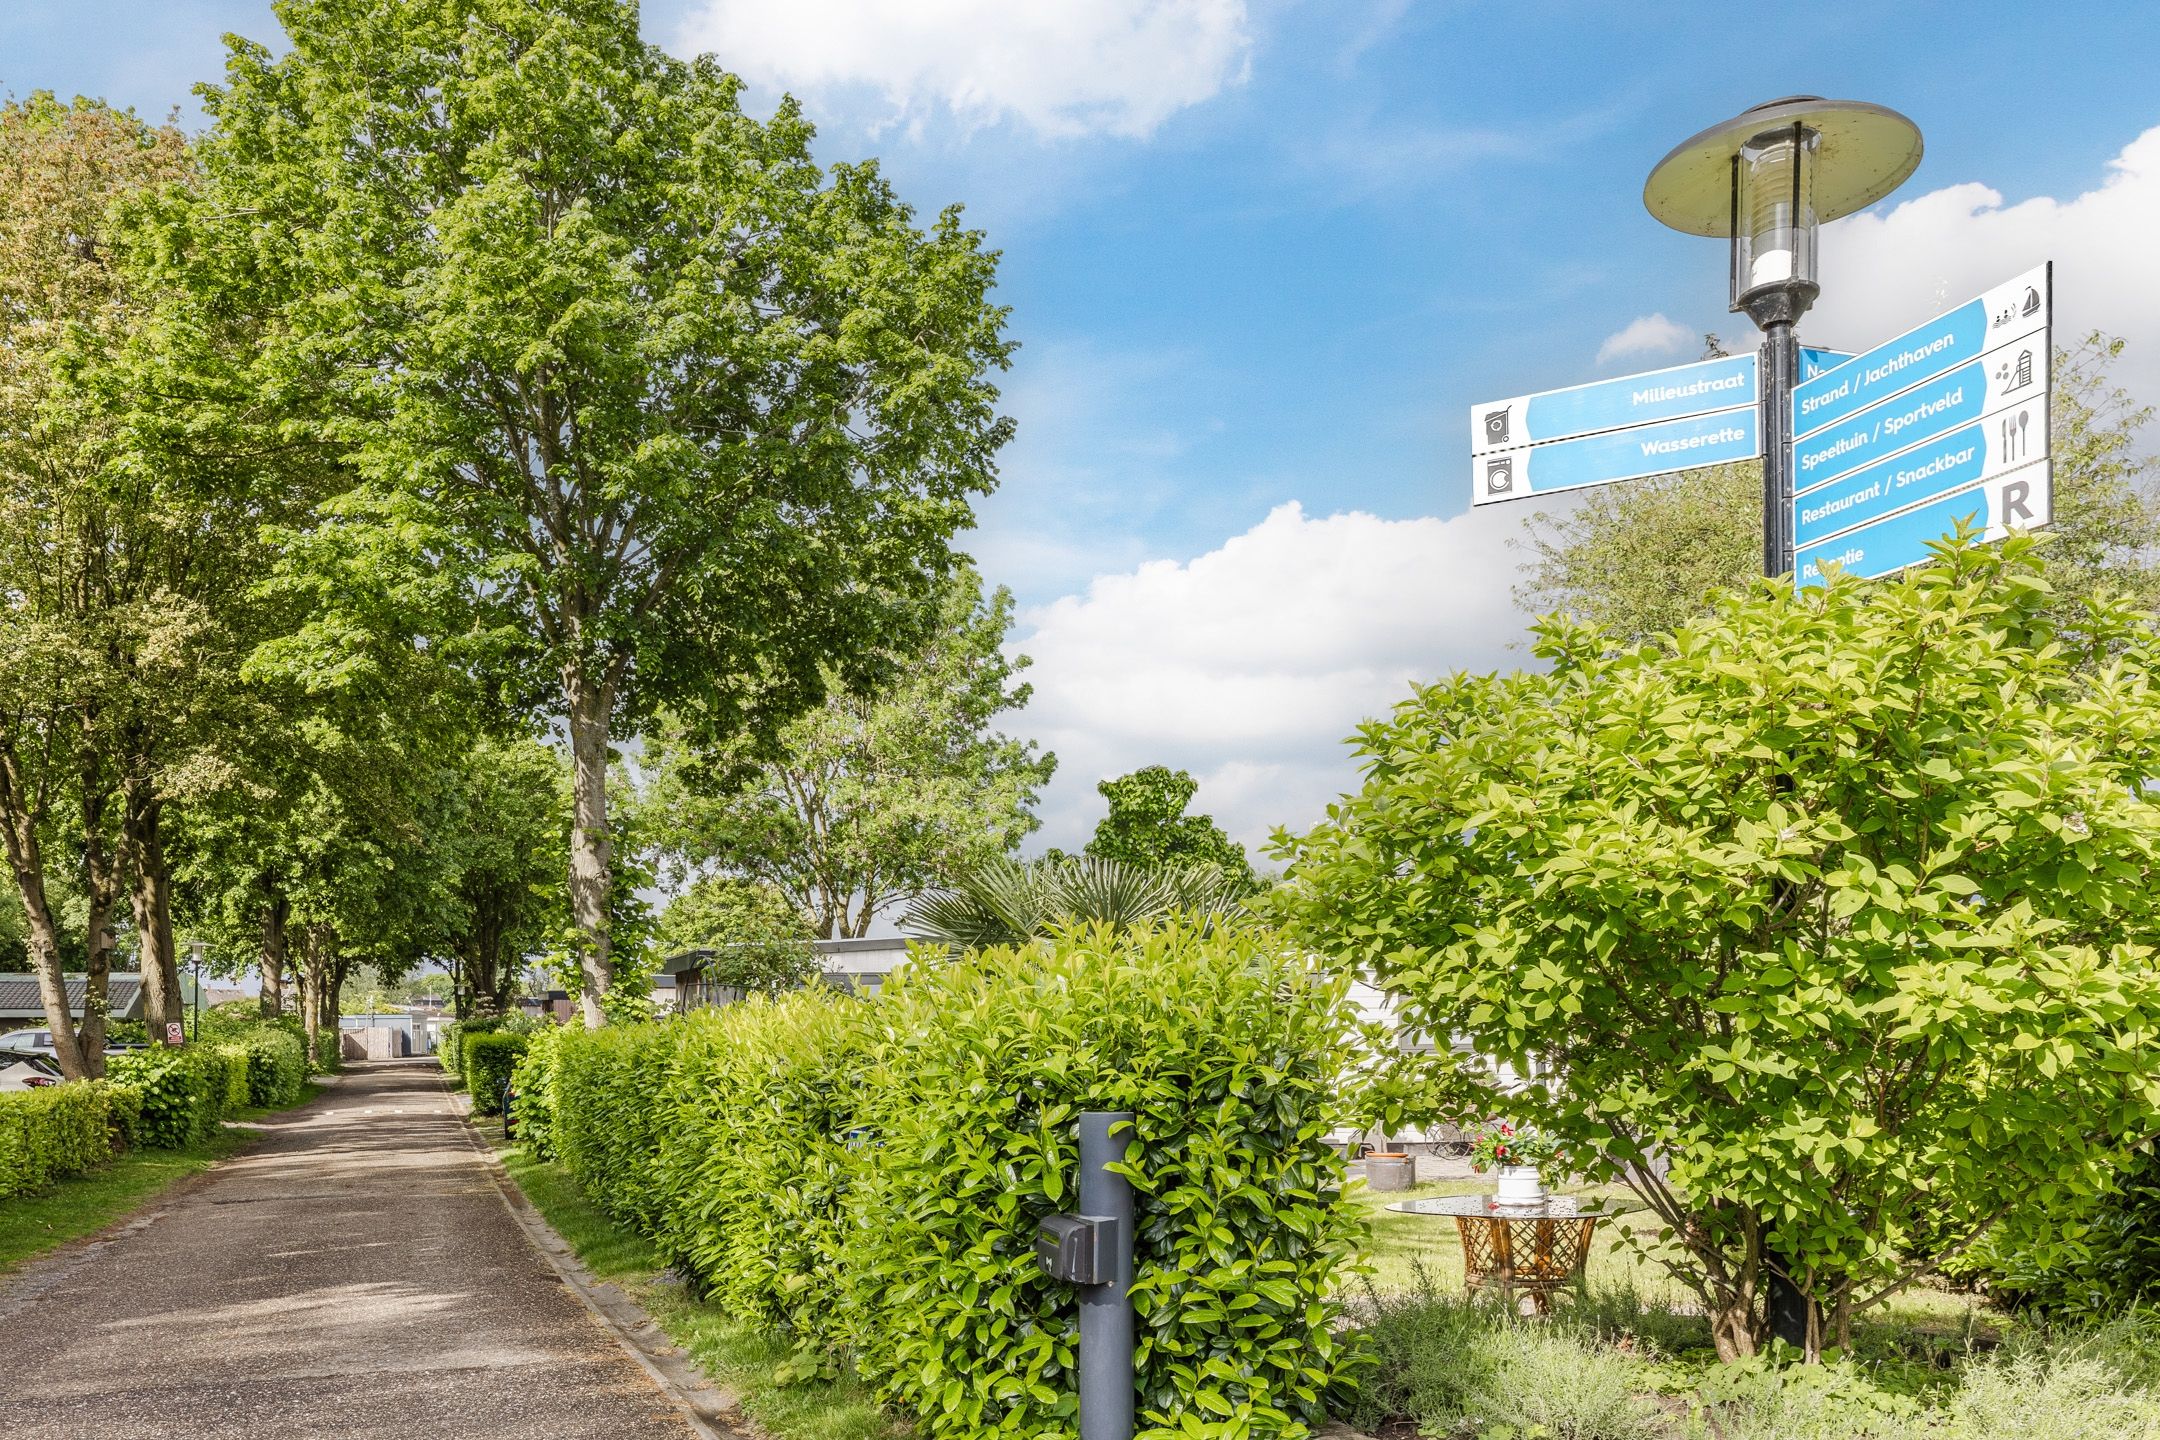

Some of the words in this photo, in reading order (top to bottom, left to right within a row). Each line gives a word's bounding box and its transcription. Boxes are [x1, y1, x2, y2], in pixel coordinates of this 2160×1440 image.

[1632, 372, 1745, 406] Milieustraat
[1801, 380, 1849, 415] Strand
[1853, 372, 1861, 394] /
[1863, 332, 1954, 387] Jachthaven
[1640, 427, 1745, 457] Wasserette
[1801, 432, 1868, 471] Speeltuin
[1872, 422, 1880, 443] /
[1884, 386, 1963, 435] Sportveld
[1801, 481, 1880, 526] Restaurant
[1883, 475, 1893, 497] /
[1896, 445, 1975, 488] Snackbar
[2002, 480, 2034, 525] R
[1803, 549, 1864, 580] Retie
